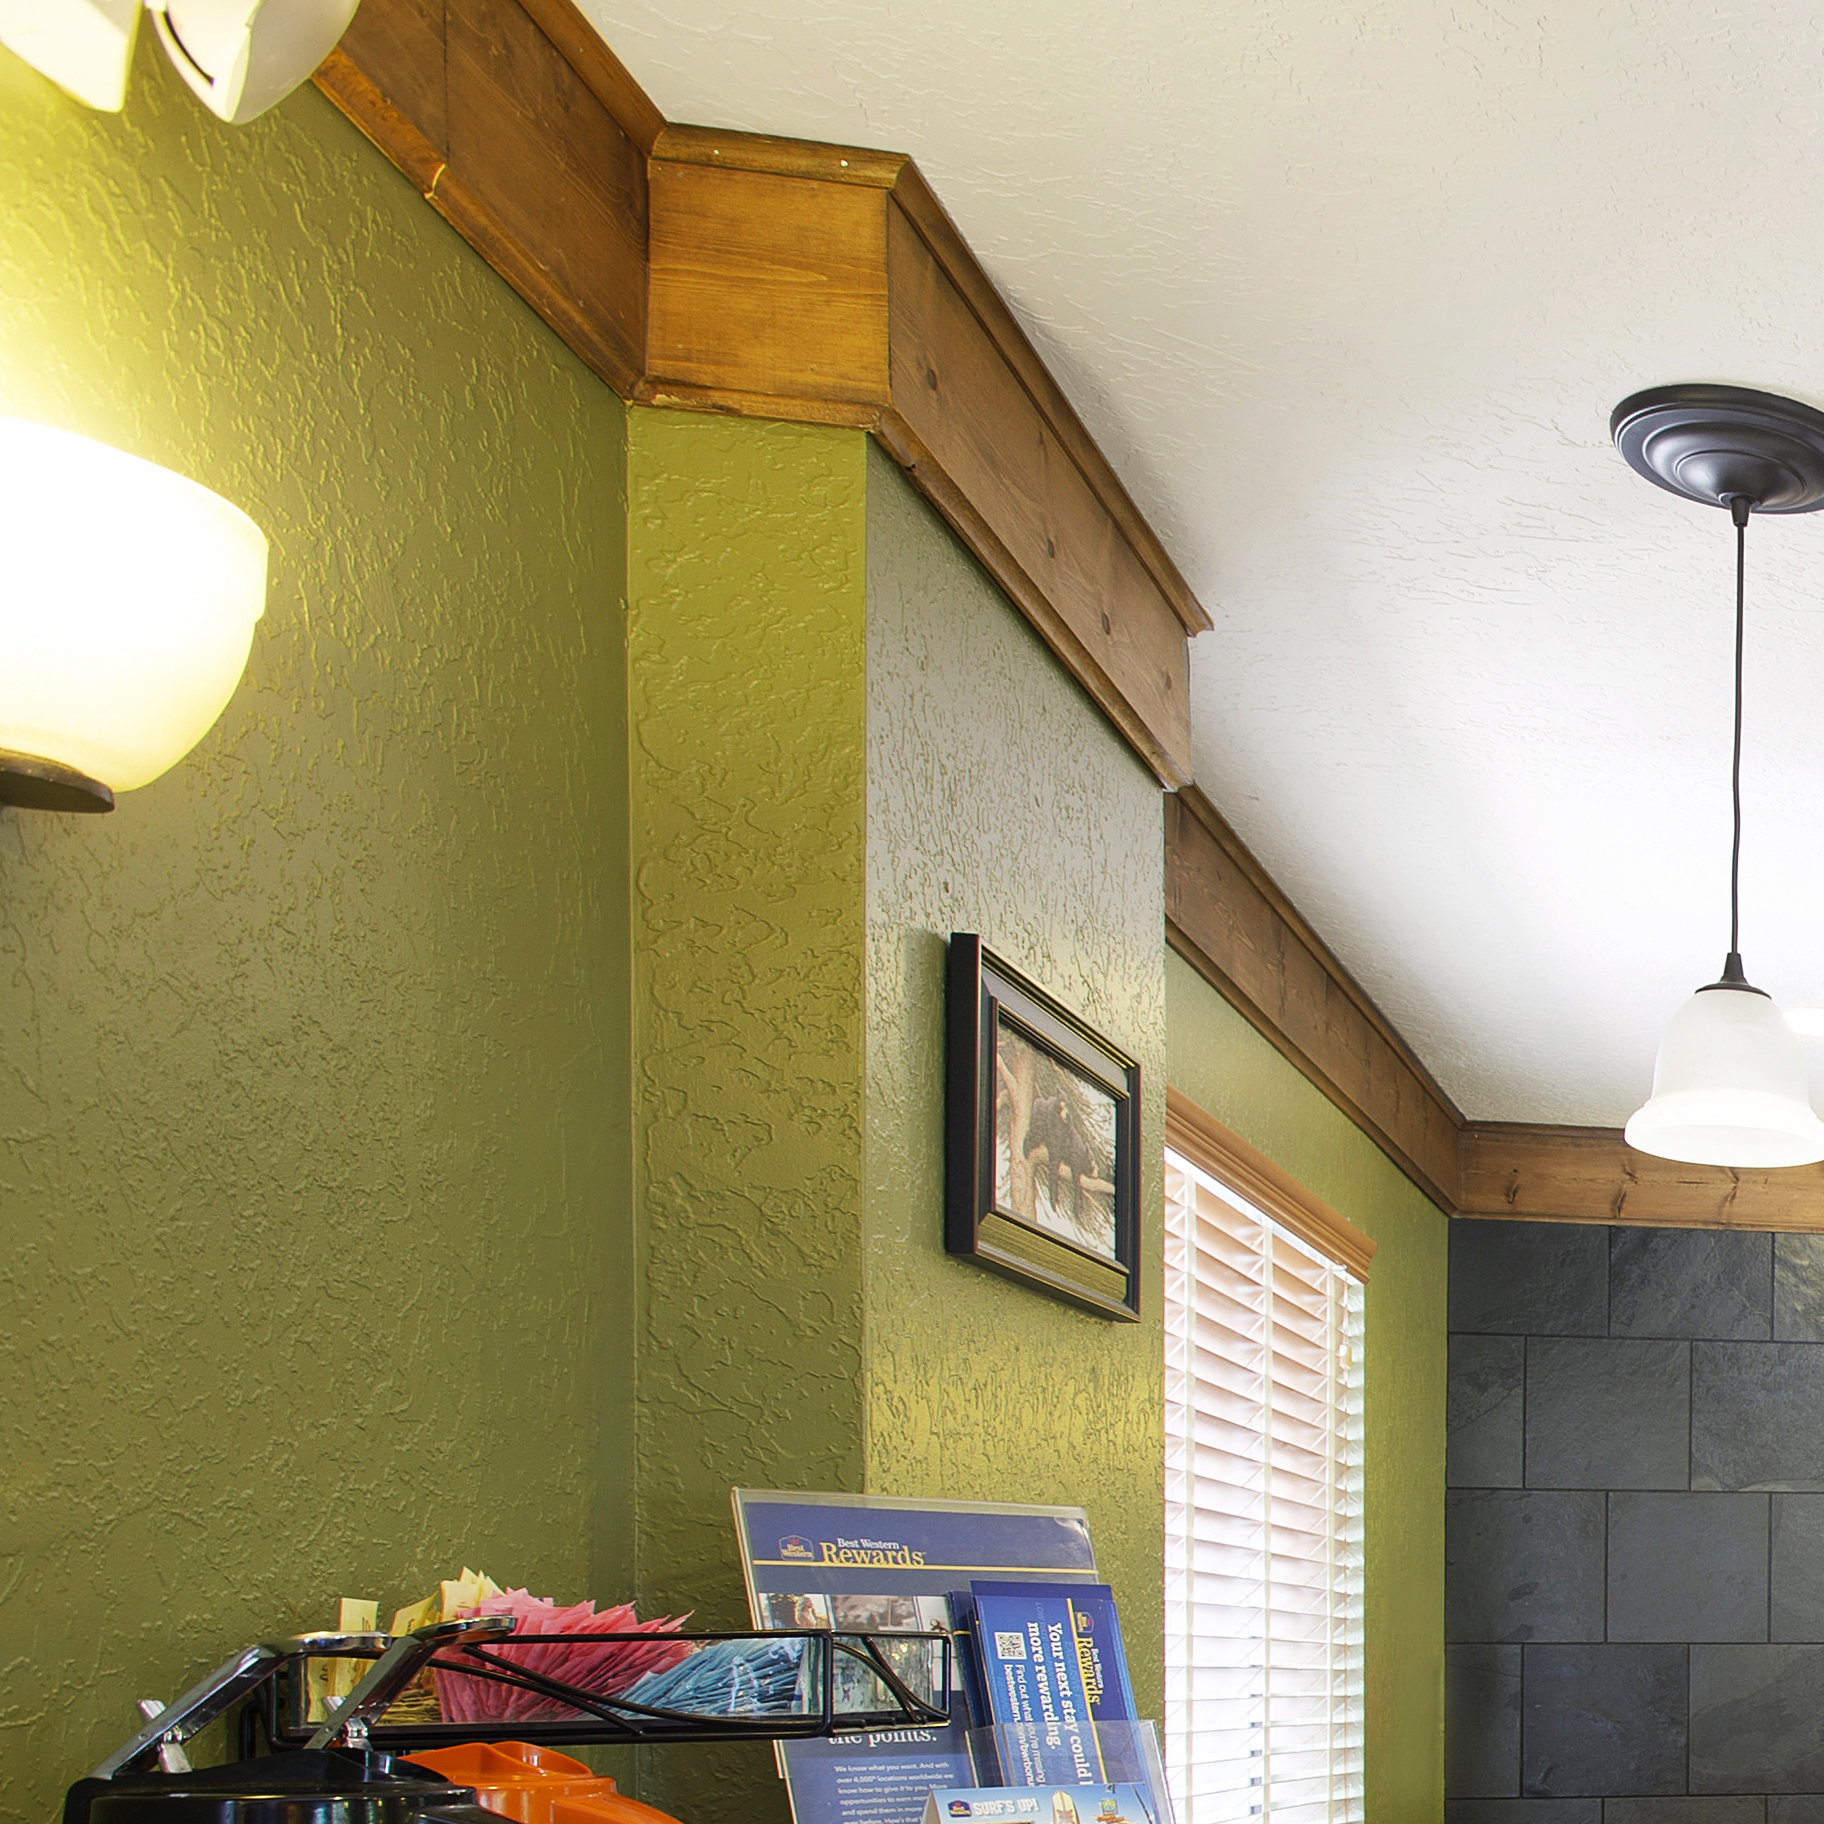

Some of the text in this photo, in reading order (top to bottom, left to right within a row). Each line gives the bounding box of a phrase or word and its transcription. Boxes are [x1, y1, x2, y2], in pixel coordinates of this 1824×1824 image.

[819, 1542, 924, 1565] Rewards
[838, 1538, 899, 1549] Best Western
[1014, 1663, 1027, 1683] Find
[1076, 1634, 1104, 1704] Rewards
[1018, 1683, 1028, 1699] out
[1026, 1620, 1062, 1750] more rewarding.
[1021, 1699, 1034, 1722] what
[1048, 1622, 1092, 1779] Your next stay could
[1003, 1662, 1035, 1788] bestwestern.com/bwrbonu
[1030, 1748, 1047, 1783] missing
[973, 1798, 1039, 1815] SURF'S UP!
